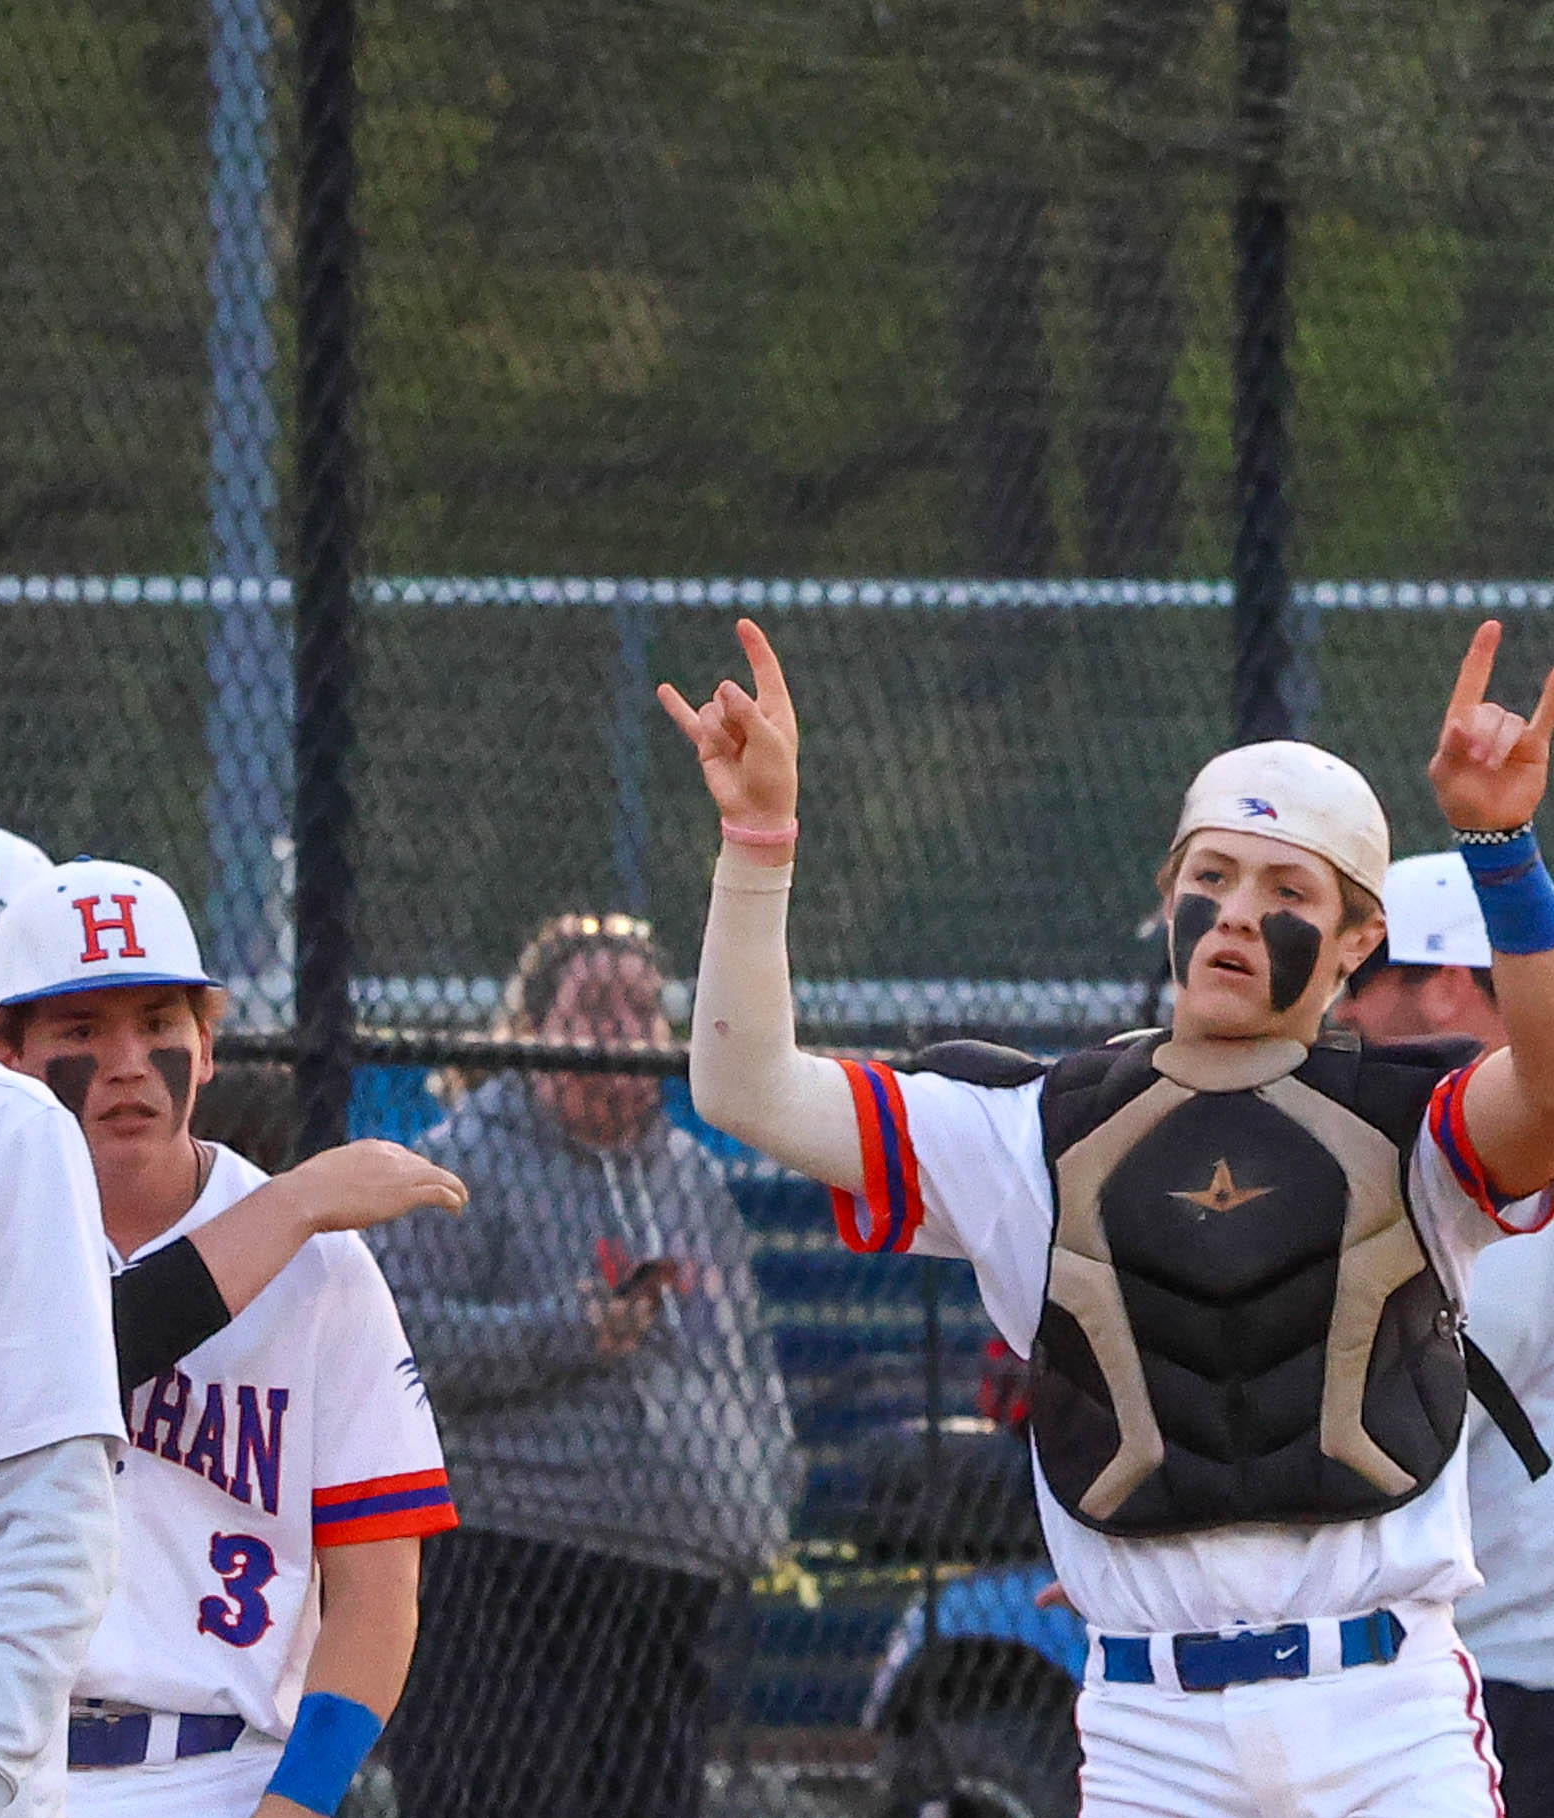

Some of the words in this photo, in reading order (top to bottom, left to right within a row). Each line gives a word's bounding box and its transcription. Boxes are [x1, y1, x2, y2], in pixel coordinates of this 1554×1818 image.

[71, 893, 147, 963] H
[128, 1374, 290, 1517] HAN
[198, 1532, 278, 1648] 3
